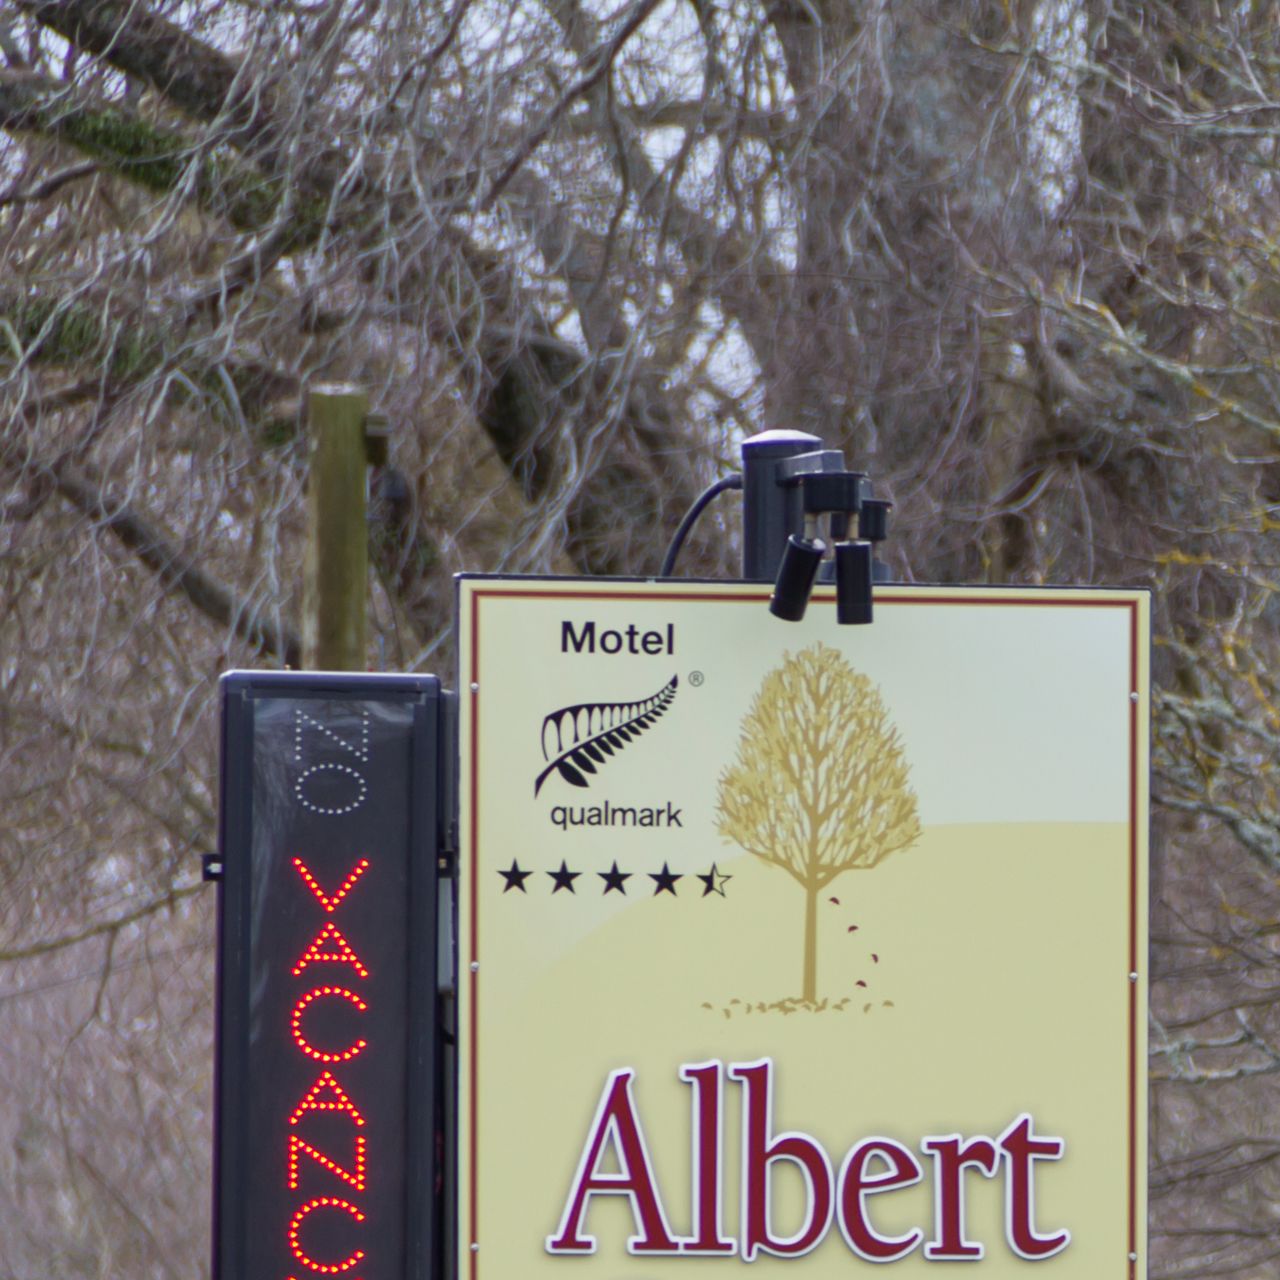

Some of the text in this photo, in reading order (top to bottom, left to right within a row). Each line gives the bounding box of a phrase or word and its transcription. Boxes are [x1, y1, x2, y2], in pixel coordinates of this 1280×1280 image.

[562, 622, 674, 655] Motel
[295, 710, 369, 814] NO
[550, 801, 682, 830] qualmark
[546, 1058, 1071, 1262] Albert
